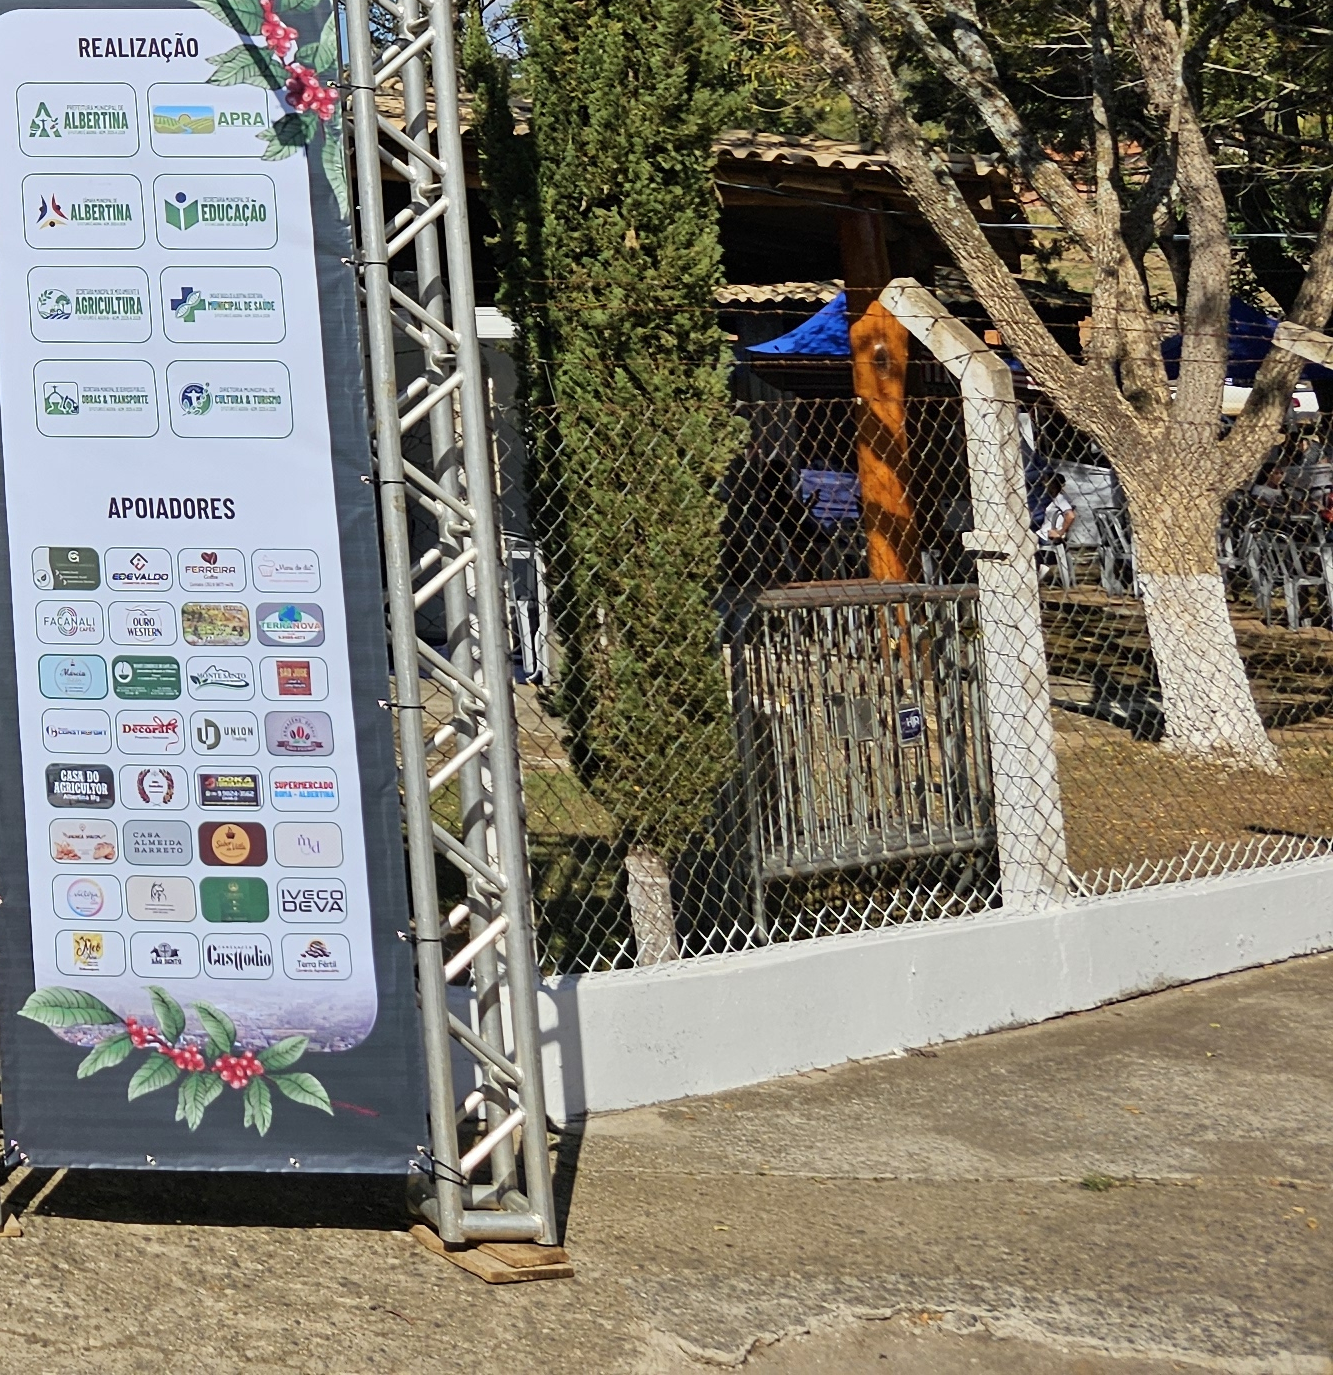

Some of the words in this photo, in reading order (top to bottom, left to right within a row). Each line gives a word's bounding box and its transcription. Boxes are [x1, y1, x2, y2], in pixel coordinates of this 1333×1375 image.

[78, 33, 199, 63] REALIZAÇÃO
[64, 112, 129, 130] ALBERTINA
[218, 112, 265, 126] APRA
[70, 204, 133, 221] ALBERTINA
[201, 199, 267, 227] EDUCAÇÃO
[75, 296, 144, 315] AGRICULTURA
[208, 301, 242, 311] MUNICIPAL
[244, 301, 252, 311] DE
[254, 299, 275, 311] SAÚDE
[82, 395, 102, 404] OBRAS
[109, 395, 149, 405] TRANSPORTE
[214, 395, 244, 405] CULTURA
[253, 395, 282, 405] TURISMO
[108, 497, 236, 520] APOIADORES
[185, 566, 236, 574] FERREIRA
[44, 616, 95, 626] FACANALI
[133, 617, 154, 627] OURO
[127, 628, 162, 636] WESTERN
[224, 726, 253, 735] UNION
[61, 770, 84, 781] CASA
[87, 771, 99, 782] DO
[54, 782, 108, 795] AGRICULTOR
[274, 781, 333, 789] SUPERMERCADO
[282, 889, 343, 901] IVECO
[283, 900, 344, 913] DEVA
[297, 960, 317, 968] Terra
